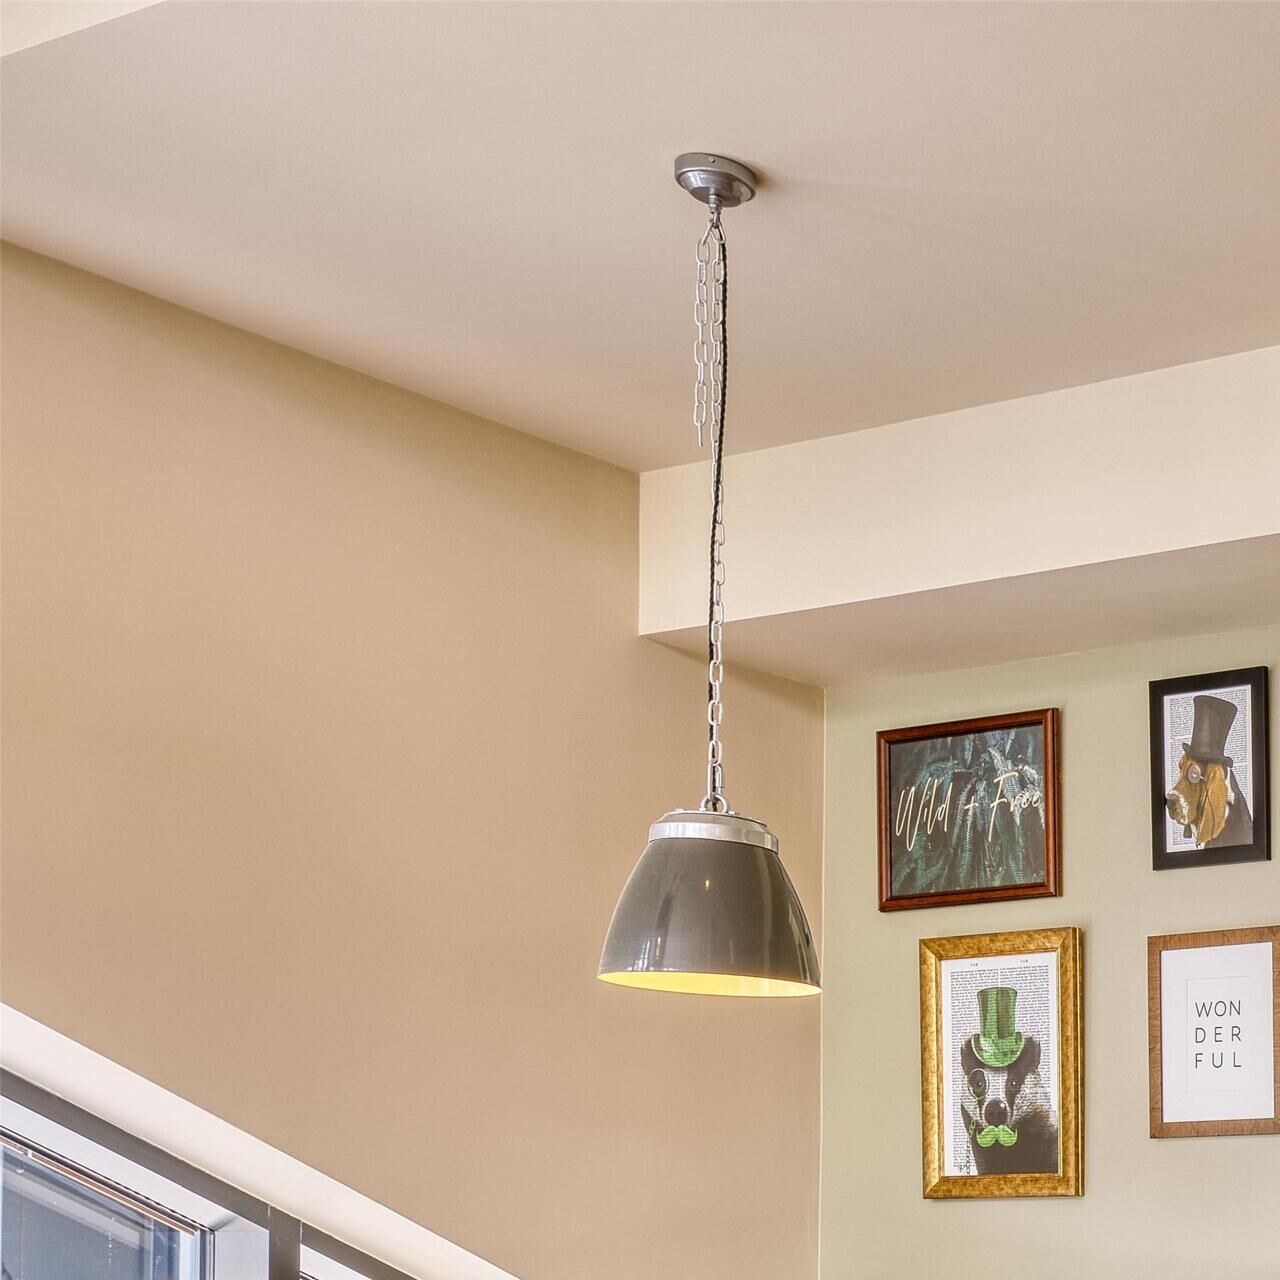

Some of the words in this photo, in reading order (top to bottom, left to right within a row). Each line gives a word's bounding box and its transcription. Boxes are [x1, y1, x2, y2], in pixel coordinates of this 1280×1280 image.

[895, 777, 953, 852] Wild
[988, 771, 1041, 842] Free
[1195, 1000, 1241, 1018] WON
[1195, 1026, 1242, 1043] DER
[1195, 1052, 1242, 1069] FUL
